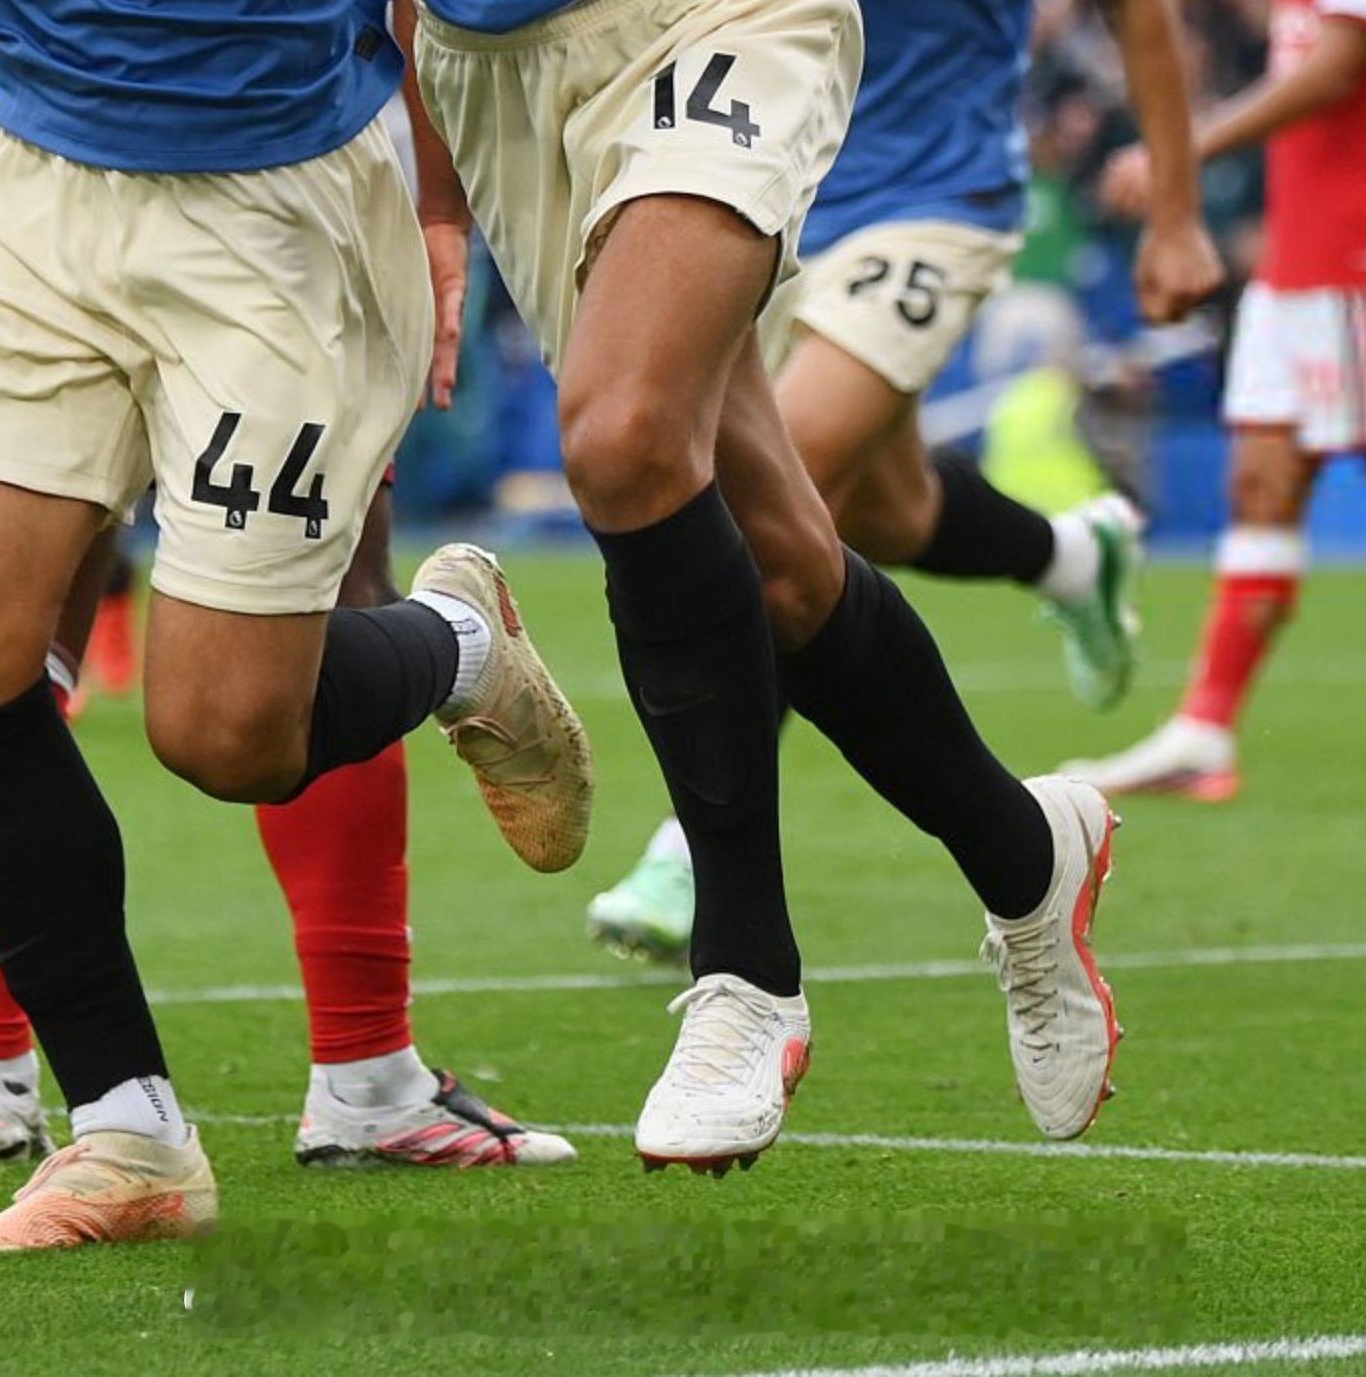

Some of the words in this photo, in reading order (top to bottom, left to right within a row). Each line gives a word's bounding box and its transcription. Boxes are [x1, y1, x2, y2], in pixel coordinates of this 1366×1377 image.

[649, 53, 761, 149] 14
[847, 256, 947, 328] 25
[191, 411, 329, 539] 44
